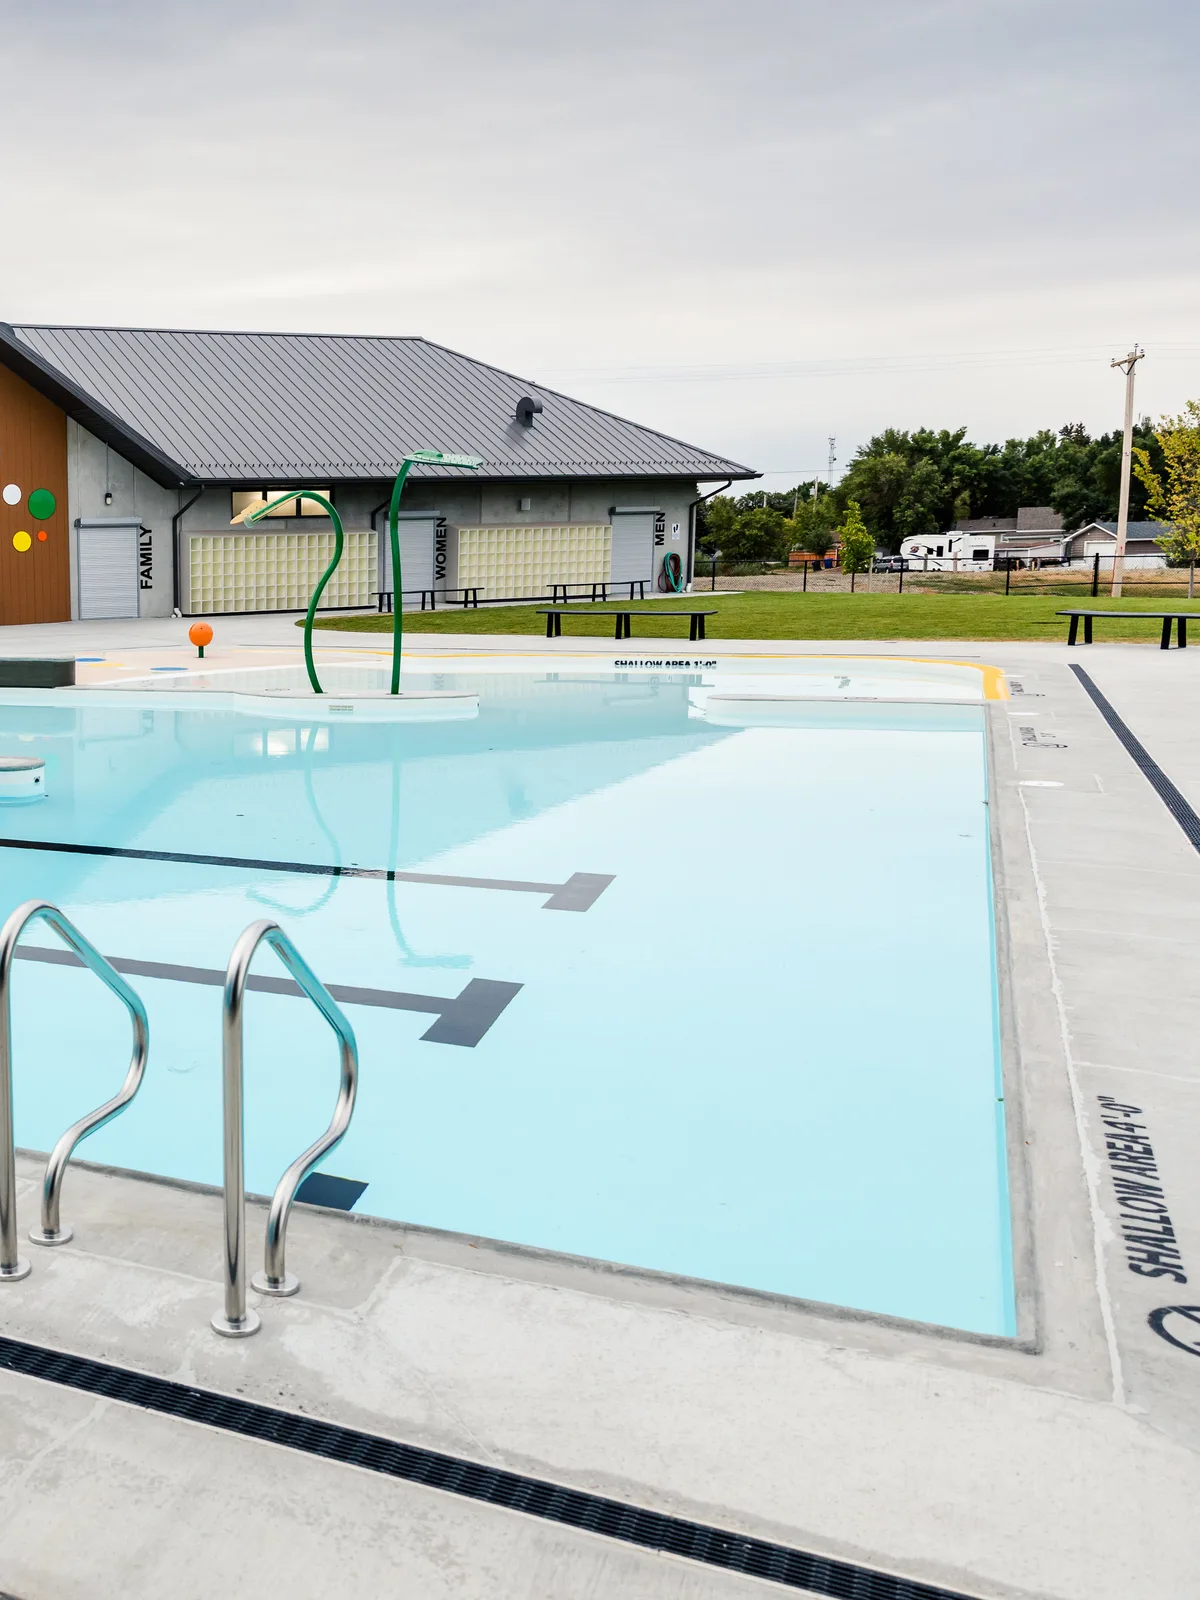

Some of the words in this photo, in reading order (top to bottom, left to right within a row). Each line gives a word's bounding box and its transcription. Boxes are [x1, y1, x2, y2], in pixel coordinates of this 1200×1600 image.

[139, 524, 153, 589] FAMILY
[435, 517, 447, 580] WOMEN
[655, 512, 666, 546] MEN
[1096, 1095, 1147, 1133] 4'-0"
[1104, 1132, 1160, 1180] AREA
[1112, 1176, 1188, 1285] SHALLOW
